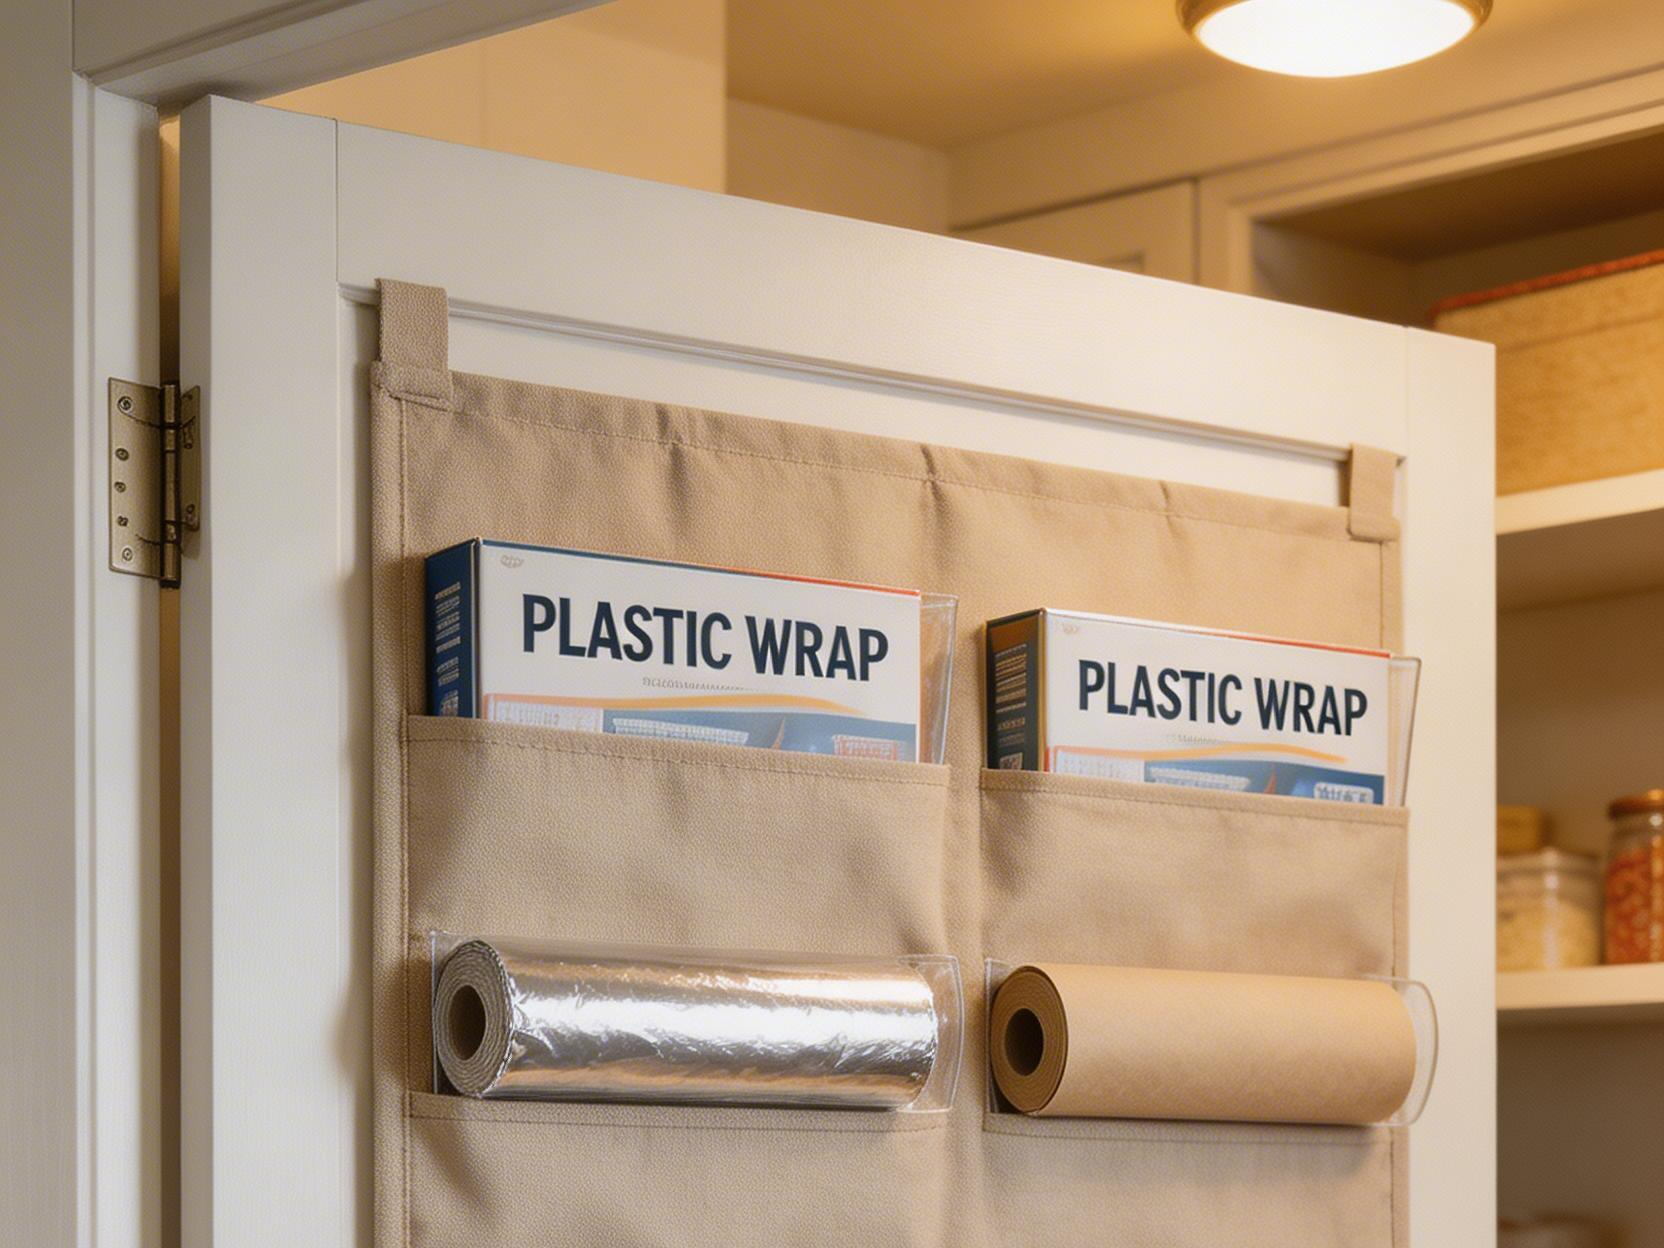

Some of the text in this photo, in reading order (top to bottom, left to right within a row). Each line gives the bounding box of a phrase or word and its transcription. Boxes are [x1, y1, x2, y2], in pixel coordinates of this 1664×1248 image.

[522, 593, 732, 669] PLASTIC
[745, 615, 889, 682] WRAP
[1078, 659, 1243, 726] PLASTIC
[1254, 677, 1368, 736] WRAP
